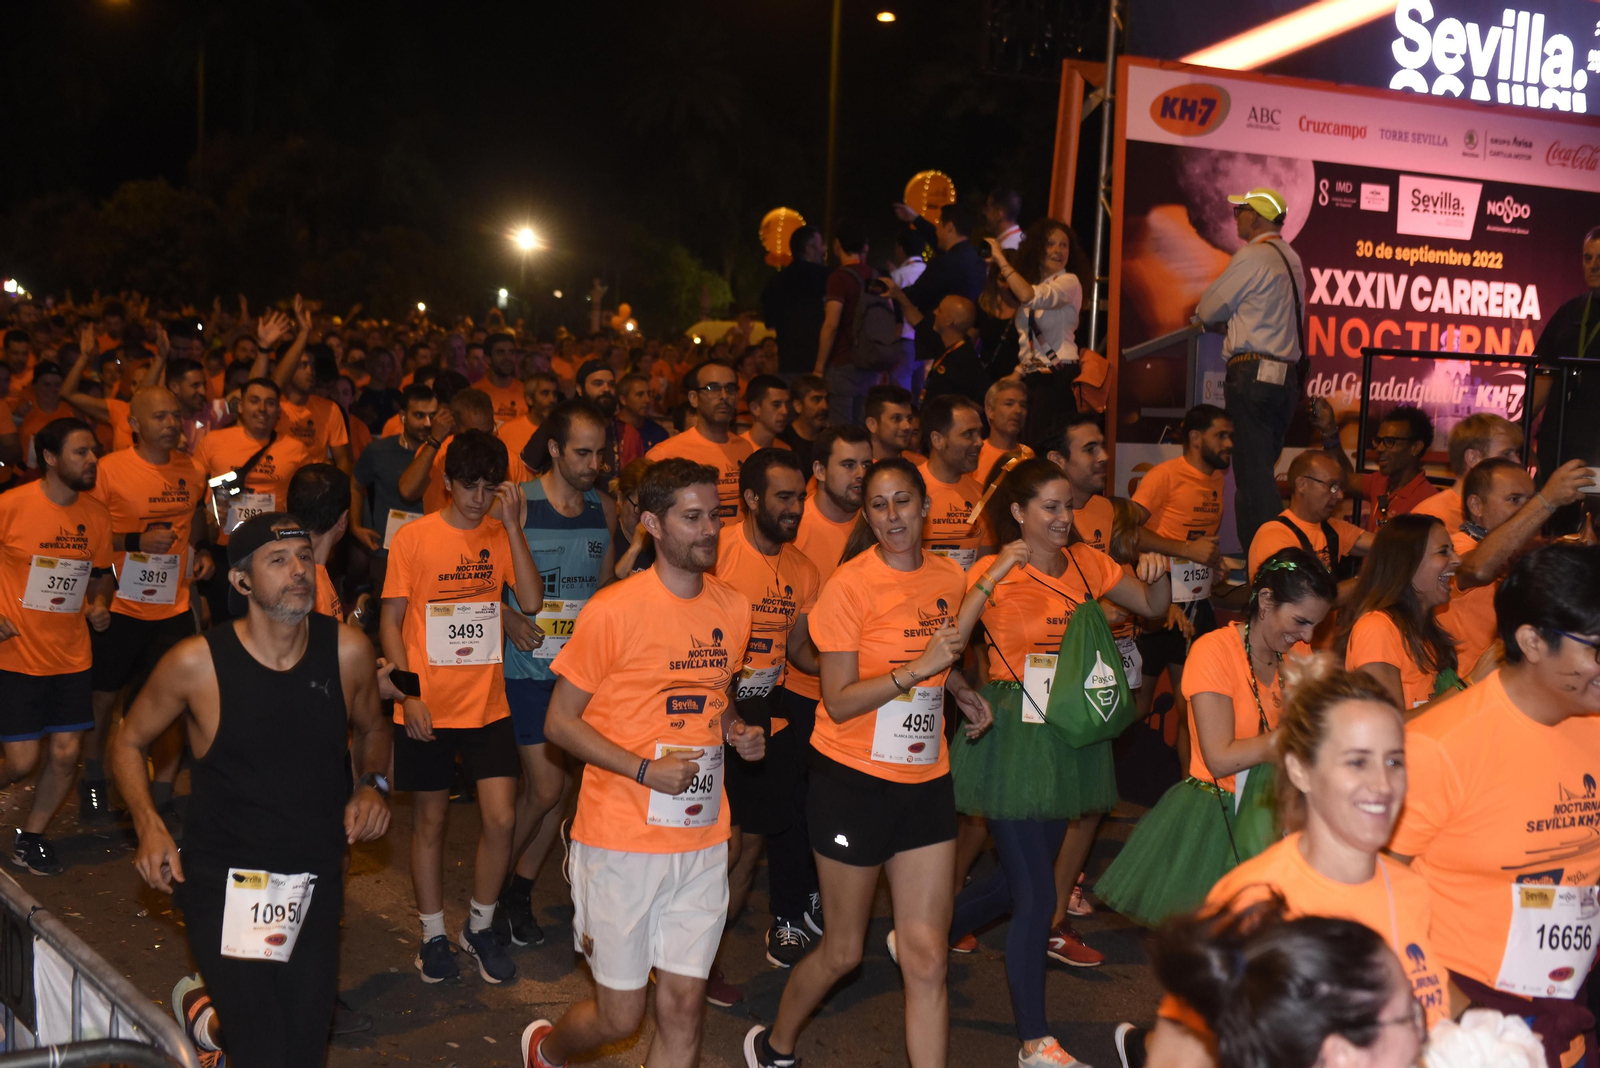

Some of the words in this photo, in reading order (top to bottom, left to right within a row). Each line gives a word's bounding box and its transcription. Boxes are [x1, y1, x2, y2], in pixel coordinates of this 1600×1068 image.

[1247, 106, 1281, 125] ABC
[1298, 115, 1367, 140] Cruzcampo
[1380, 128, 1409, 143] TORRE
[1411, 132, 1448, 147] SEVILLA
[1336, 181, 1353, 193] IMD
[1356, 240, 1373, 257] 30
[1375, 242, 1393, 259] de
[1395, 244, 1472, 267] septiembre
[1472, 250, 1503, 269] 2022
[1309, 267, 1408, 311] XXXIV
[1410, 275, 1541, 320] CARRERA
[1307, 372, 1338, 398] del
[588, 541, 602, 554] 365
[139, 570, 168, 583] 3819
[438, 572, 472, 581] SEVILLA
[1183, 568, 1210, 582] 21525
[47, 576, 78, 591] 3767
[762, 598, 796, 607] NOCTURNA
[448, 624, 484, 639] 3493
[688, 649, 728, 658] NOCTURNA
[669, 661, 708, 670] SEVILLA
[1123, 656, 1135, 669] 61
[738, 686, 769, 698] 6575
[903, 713, 934, 732] 4950
[1526, 817, 1576, 832] SEVILLA
[250, 902, 301, 924] 10950
[1536, 923, 1592, 950] 16656
